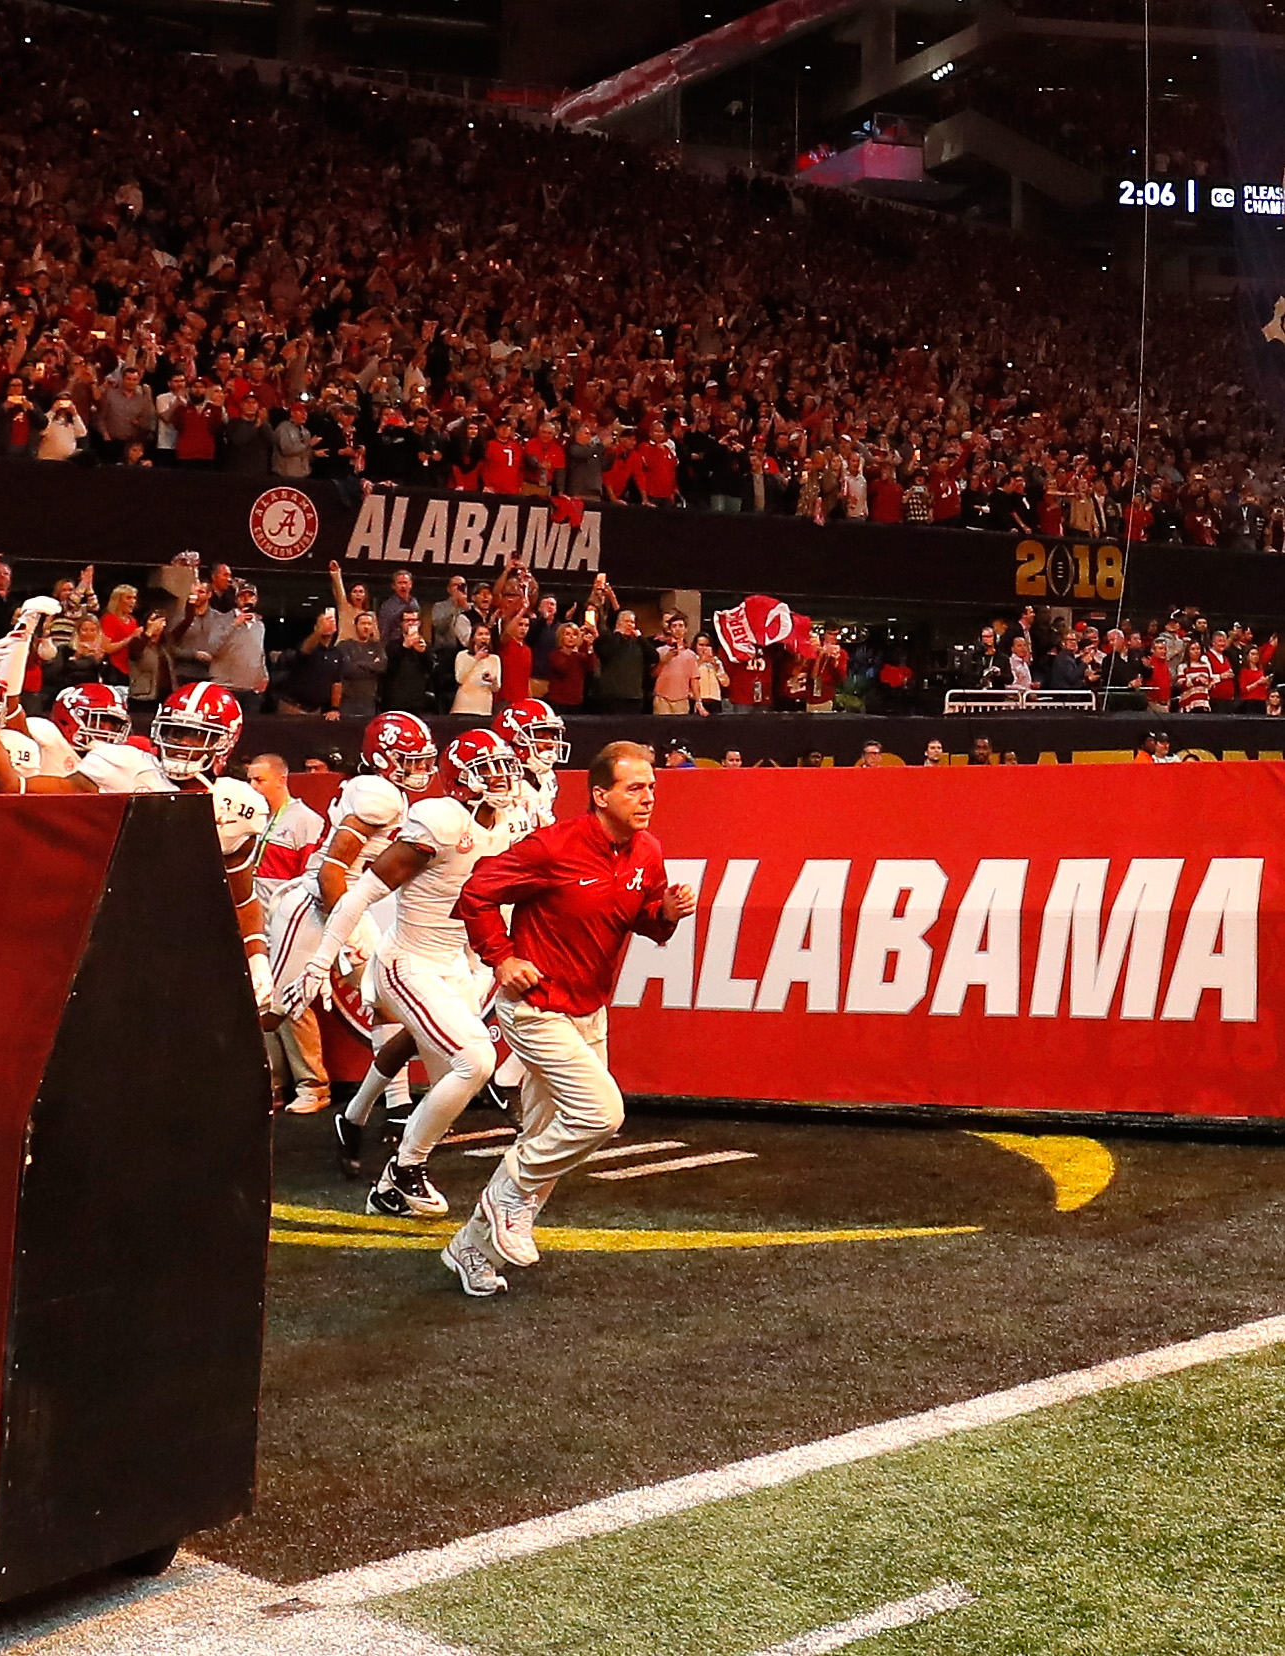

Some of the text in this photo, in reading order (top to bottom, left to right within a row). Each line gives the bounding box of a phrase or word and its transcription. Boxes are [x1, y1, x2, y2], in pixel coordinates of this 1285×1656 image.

[1118, 180, 1176, 207] 2:06
[1244, 200, 1285, 215] CHAM
[268, 508, 297, 538] A
[345, 494, 602, 572] ALABAMA
[378, 723, 402, 746] 36
[238, 803, 255, 820] 18
[626, 867, 645, 891] A
[611, 857, 1264, 1023] ALABAMA
